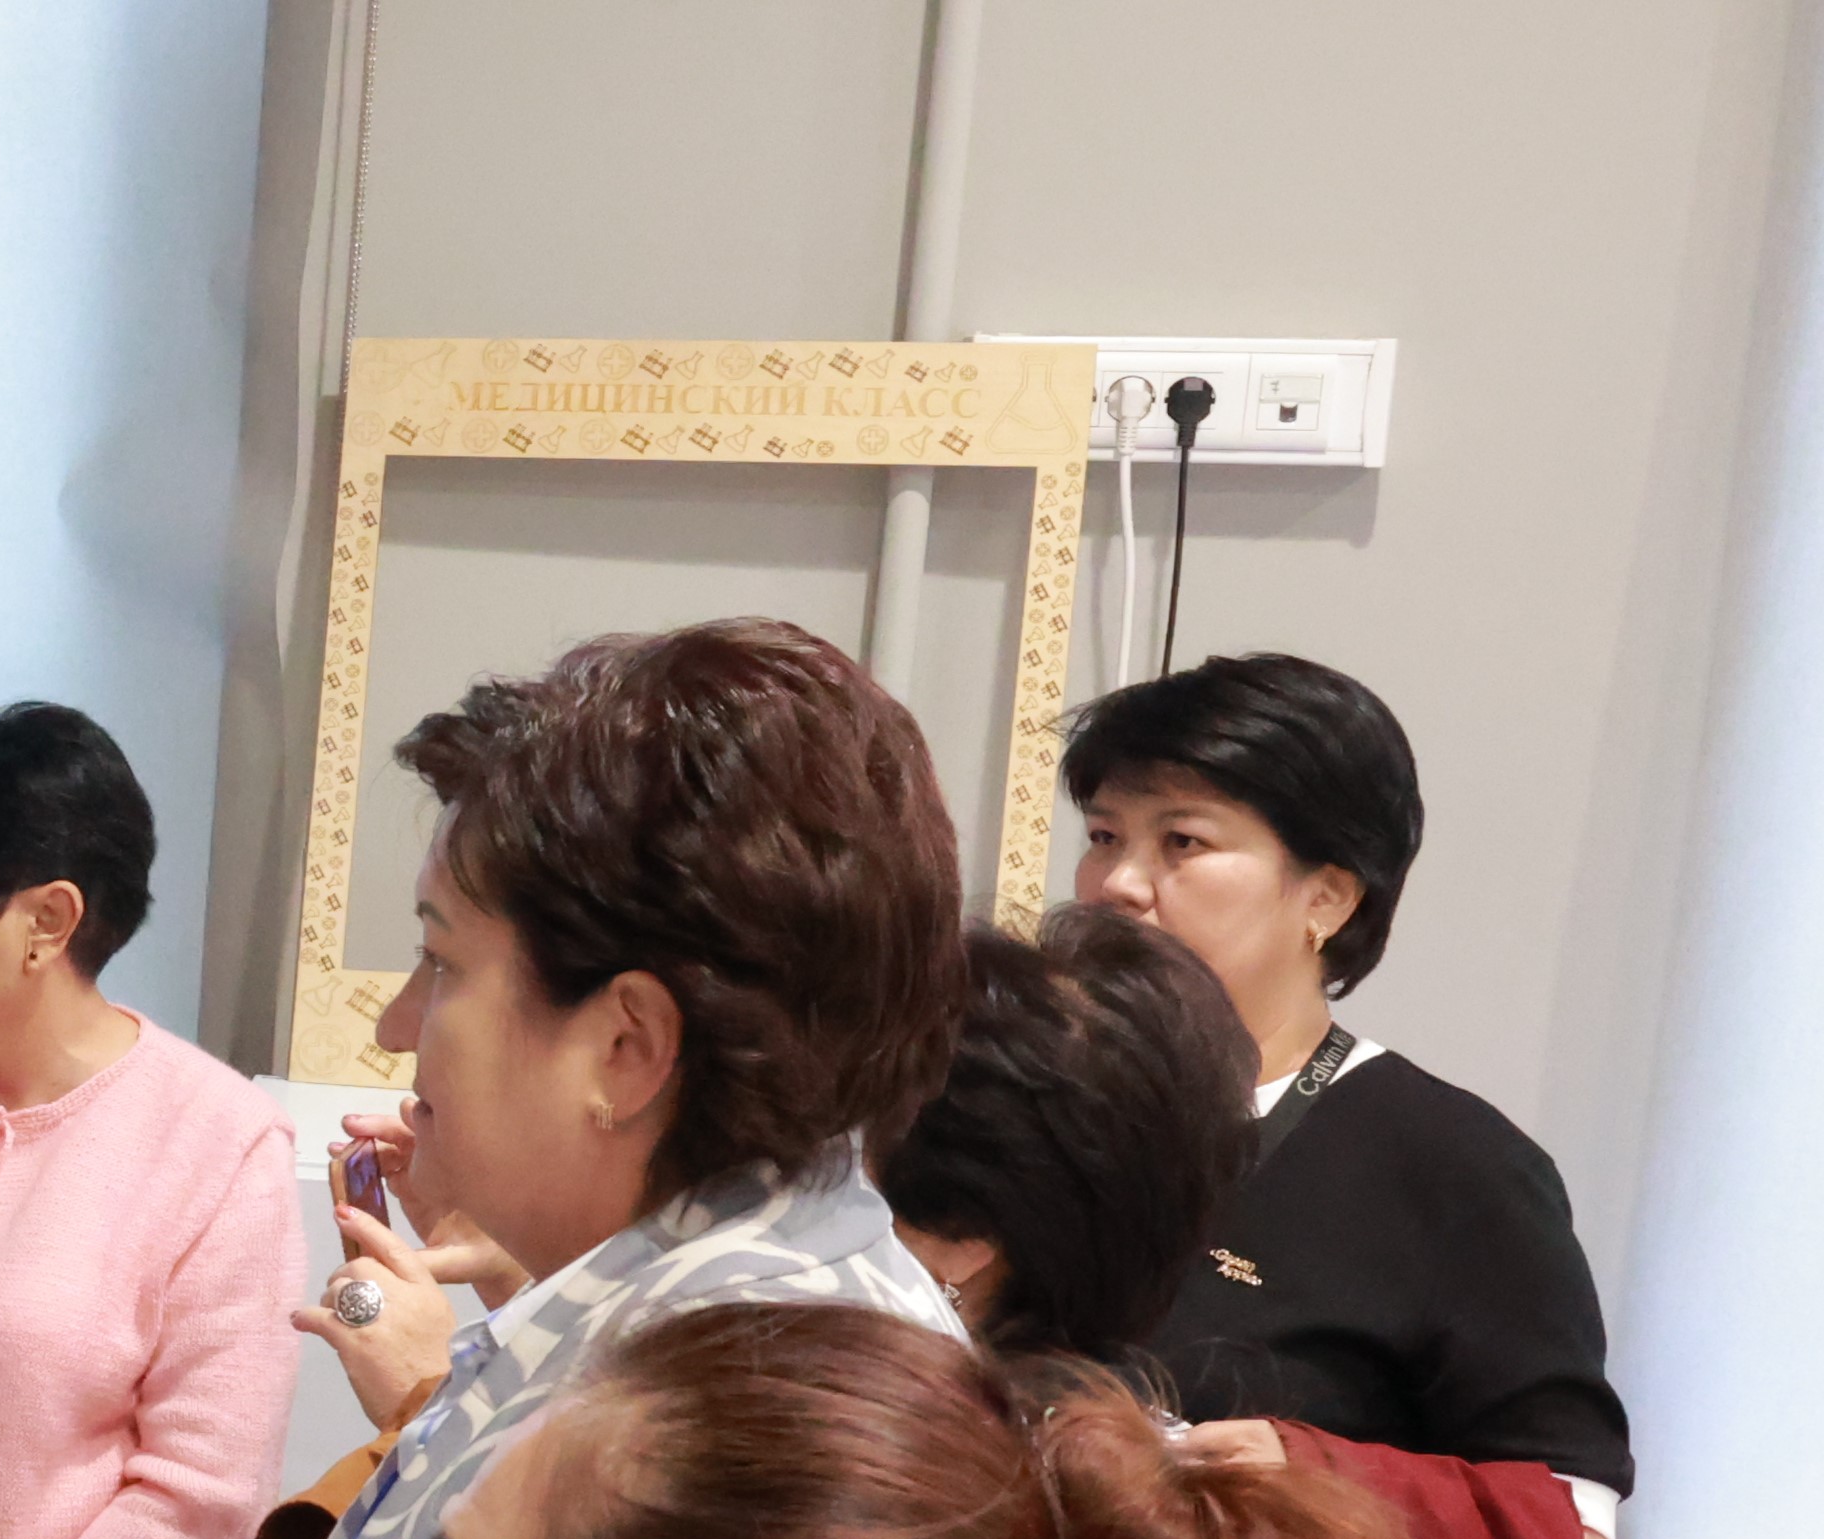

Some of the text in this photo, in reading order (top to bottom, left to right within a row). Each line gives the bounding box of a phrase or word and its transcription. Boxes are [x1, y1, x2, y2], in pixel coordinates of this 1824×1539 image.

[447, 380, 981, 419] МЕДИЦИНСКИЙ КЛАСС
[1297, 1046, 1346, 1096] Calvin
